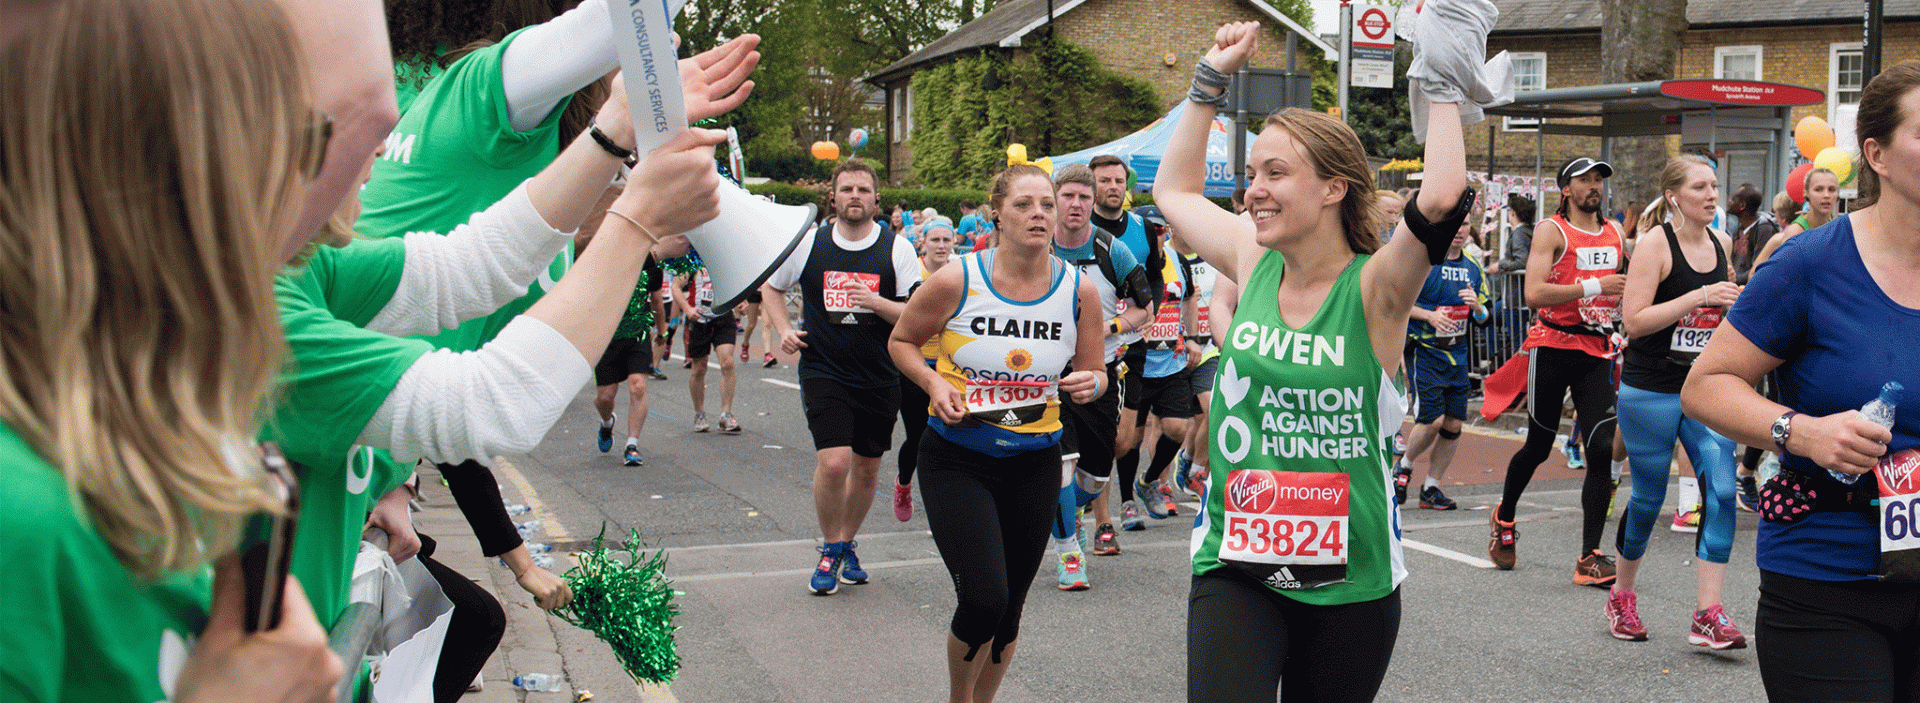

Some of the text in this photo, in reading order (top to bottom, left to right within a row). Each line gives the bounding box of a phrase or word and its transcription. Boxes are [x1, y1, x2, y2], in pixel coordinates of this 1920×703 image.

[630, 9, 659, 87] CONSULTANCY
[648, 88, 668, 133] SERVICES
[1712, 84, 1741, 93] Mudchute
[1742, 85, 1763, 94] Station
[1441, 266, 1471, 282] STEVE
[970, 316, 1062, 341] CLAIRE
[1232, 321, 1345, 366] GWEN
[1258, 385, 1364, 412] ACTION
[1261, 411, 1363, 435] AGAINST
[1261, 434, 1369, 459] HUNGER
[1884, 453, 1920, 490] Virgin
[1232, 469, 1343, 510] Virgin money
[1226, 516, 1343, 557] 53824
[1264, 579, 1301, 589] adidas
